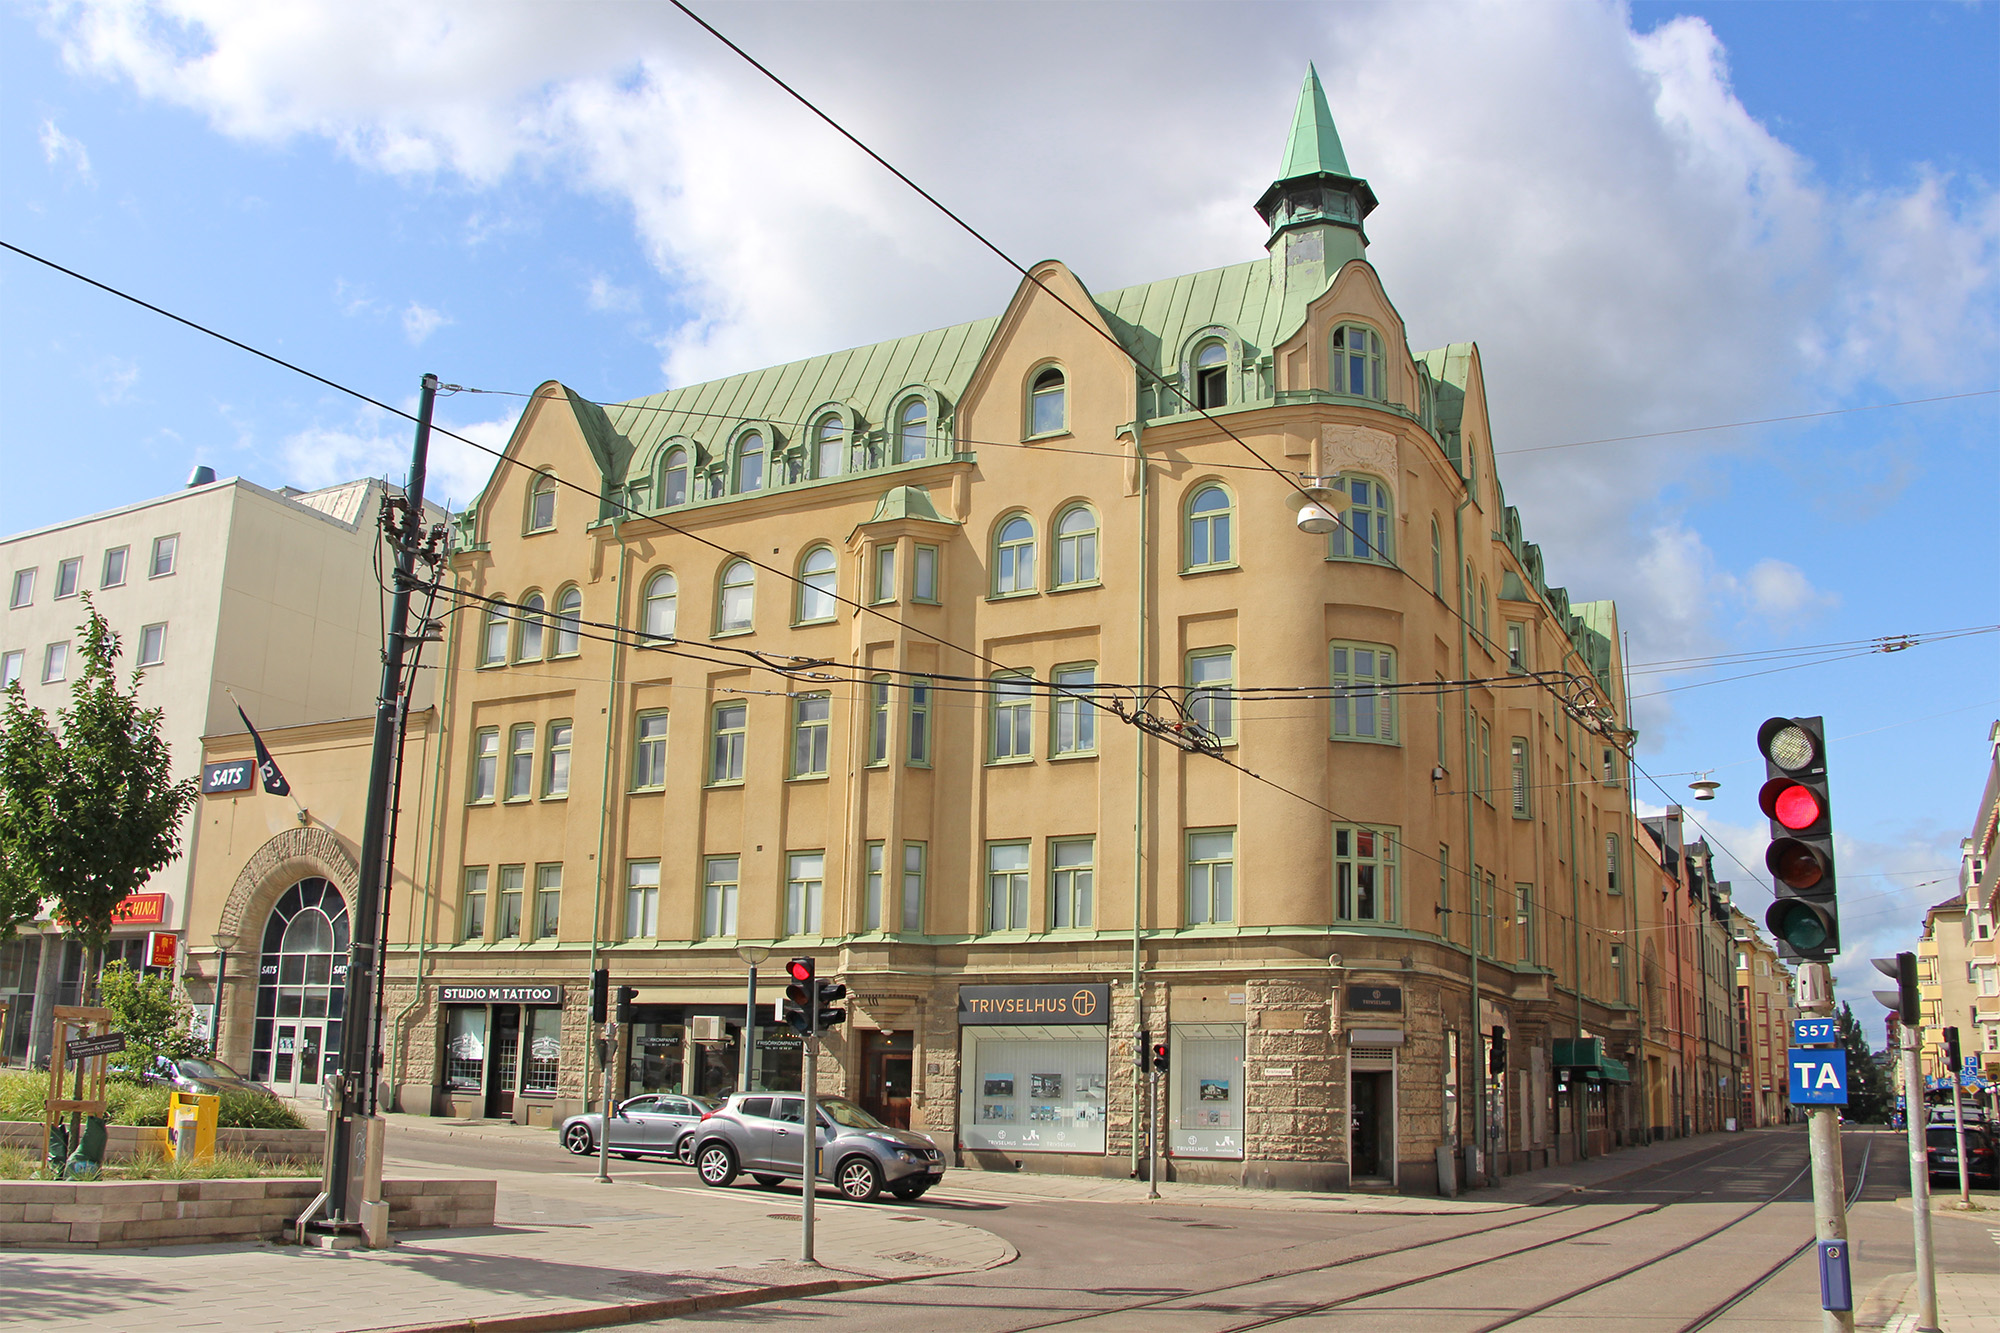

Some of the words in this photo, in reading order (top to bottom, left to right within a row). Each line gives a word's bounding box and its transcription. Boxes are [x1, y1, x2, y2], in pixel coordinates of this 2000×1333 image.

[209, 766, 245, 787] SATS
[261, 965, 278, 974] SATS
[443, 988, 487, 999] STUDIO
[488, 988, 500, 999] M
[502, 988, 552, 1000] TATTOO
[969, 998, 1068, 1013] TRIVSELHUS
[1798, 1024, 1830, 1037] S57
[1967, 1057, 1975, 1066] P
[1793, 1062, 1841, 1089] TA
